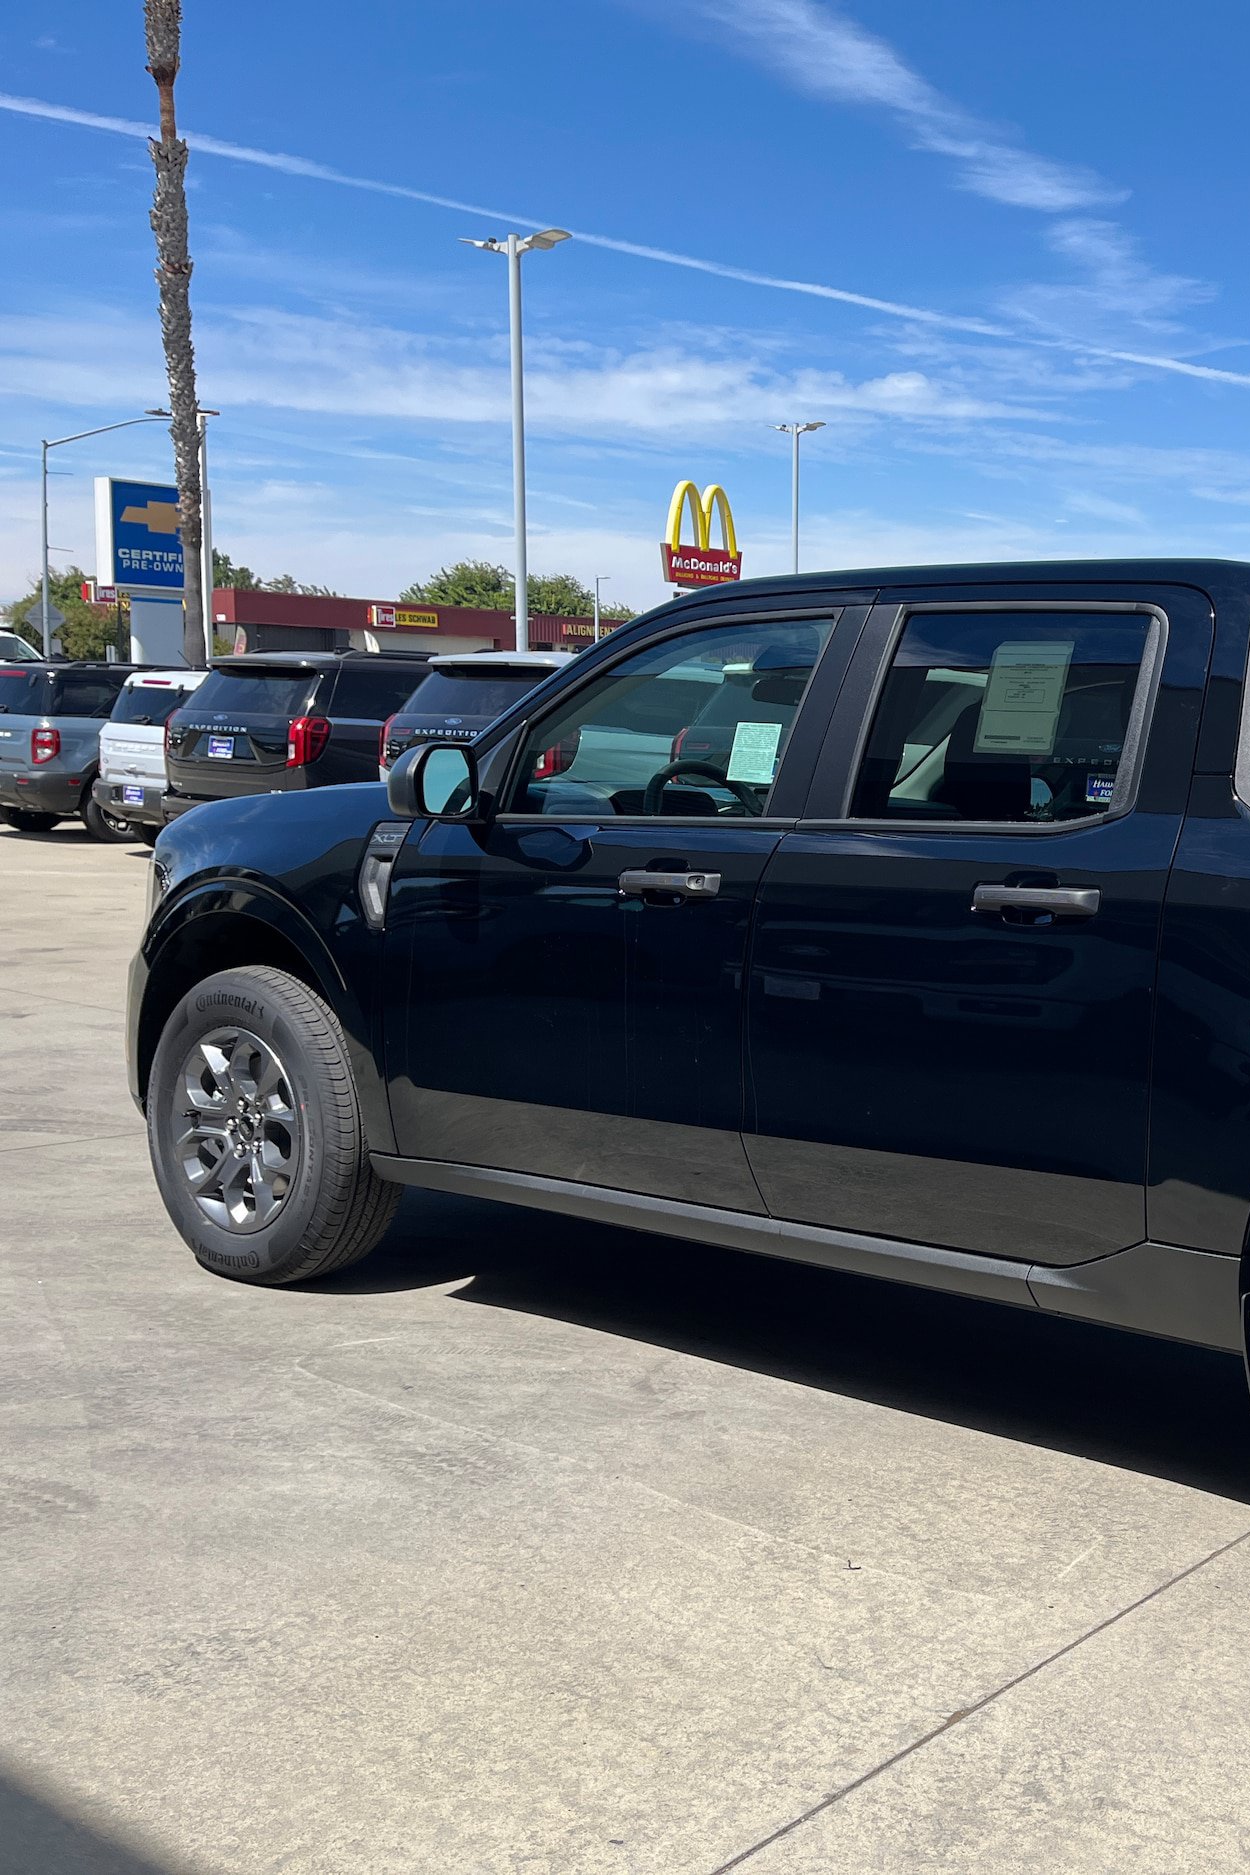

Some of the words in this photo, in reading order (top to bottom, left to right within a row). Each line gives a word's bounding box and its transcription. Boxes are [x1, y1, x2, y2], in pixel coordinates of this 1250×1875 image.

[118, 548, 183, 564] CERTIFI
[122, 560, 184, 573] PRE-OWN
[671, 556, 738, 575] McDonald's
[408, 614, 436, 625] SCHWAB
[188, 723, 248, 734] EXPEDITION
[414, 728, 479, 738] EXPEDITIO
[370, 833, 405, 844] XLT
[195, 989, 258, 1016] Continental
